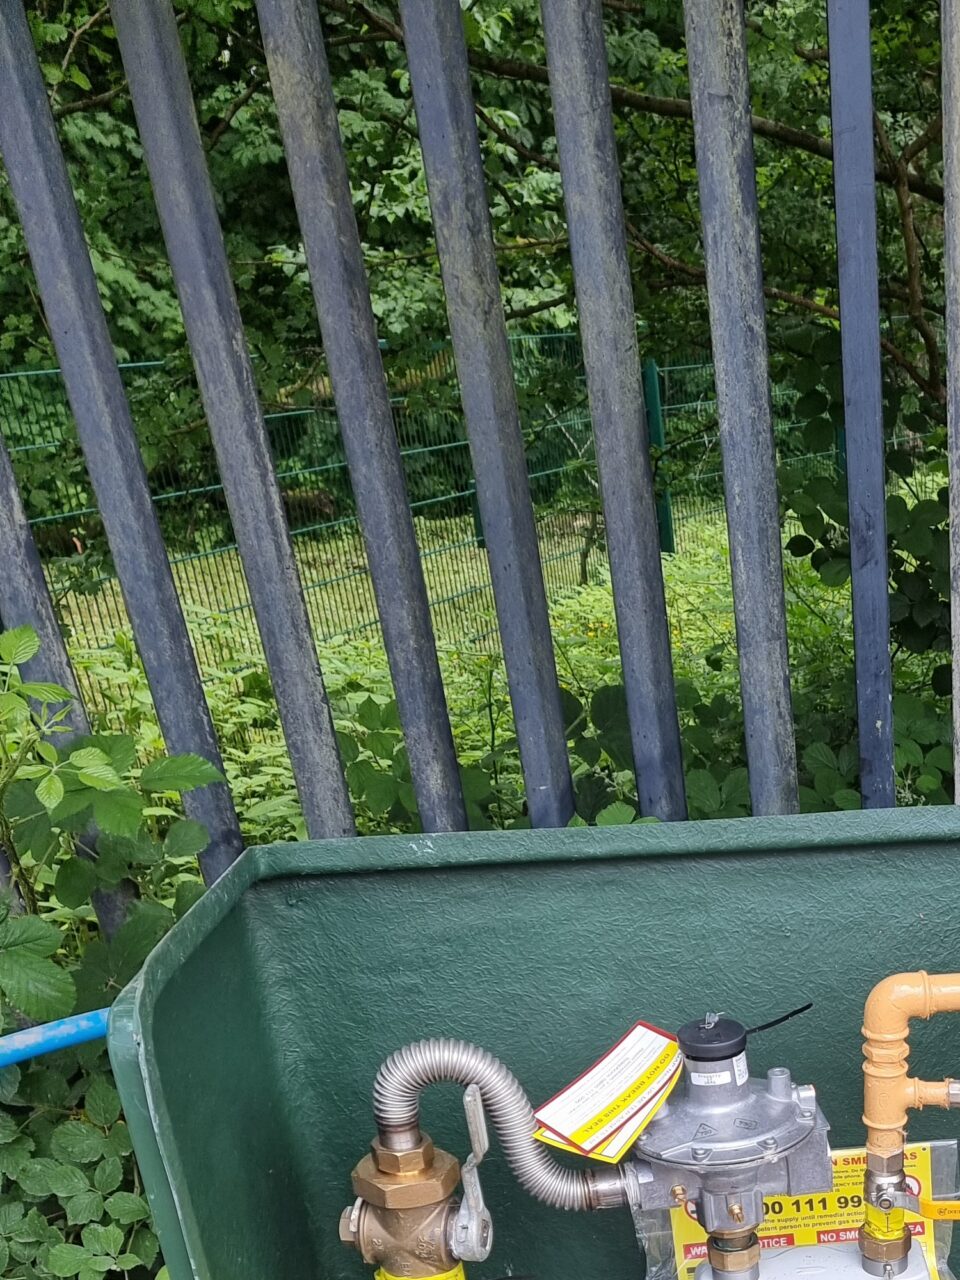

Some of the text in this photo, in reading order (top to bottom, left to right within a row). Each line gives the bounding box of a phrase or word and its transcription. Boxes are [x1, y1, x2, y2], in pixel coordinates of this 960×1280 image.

[658, 1052, 670, 1065] DO
[645, 1064, 660, 1080] NOT
[619, 1079, 645, 1103] BREAK
[602, 1102, 620, 1118] THIS
[584, 1117, 603, 1133] SEAL
[842, 1156, 868, 1166] SME
[903, 1152, 918, 1160] AS
[763, 1195, 862, 1216] 00 111 99
[756, 1225, 778, 1233] petent
[779, 1223, 802, 1231] person
[811, 1220, 837, 1228] prevent
[908, 1224, 923, 1233] EA
[761, 1237, 788, 1248] TICE
[820, 1232, 837, 1242] NO
